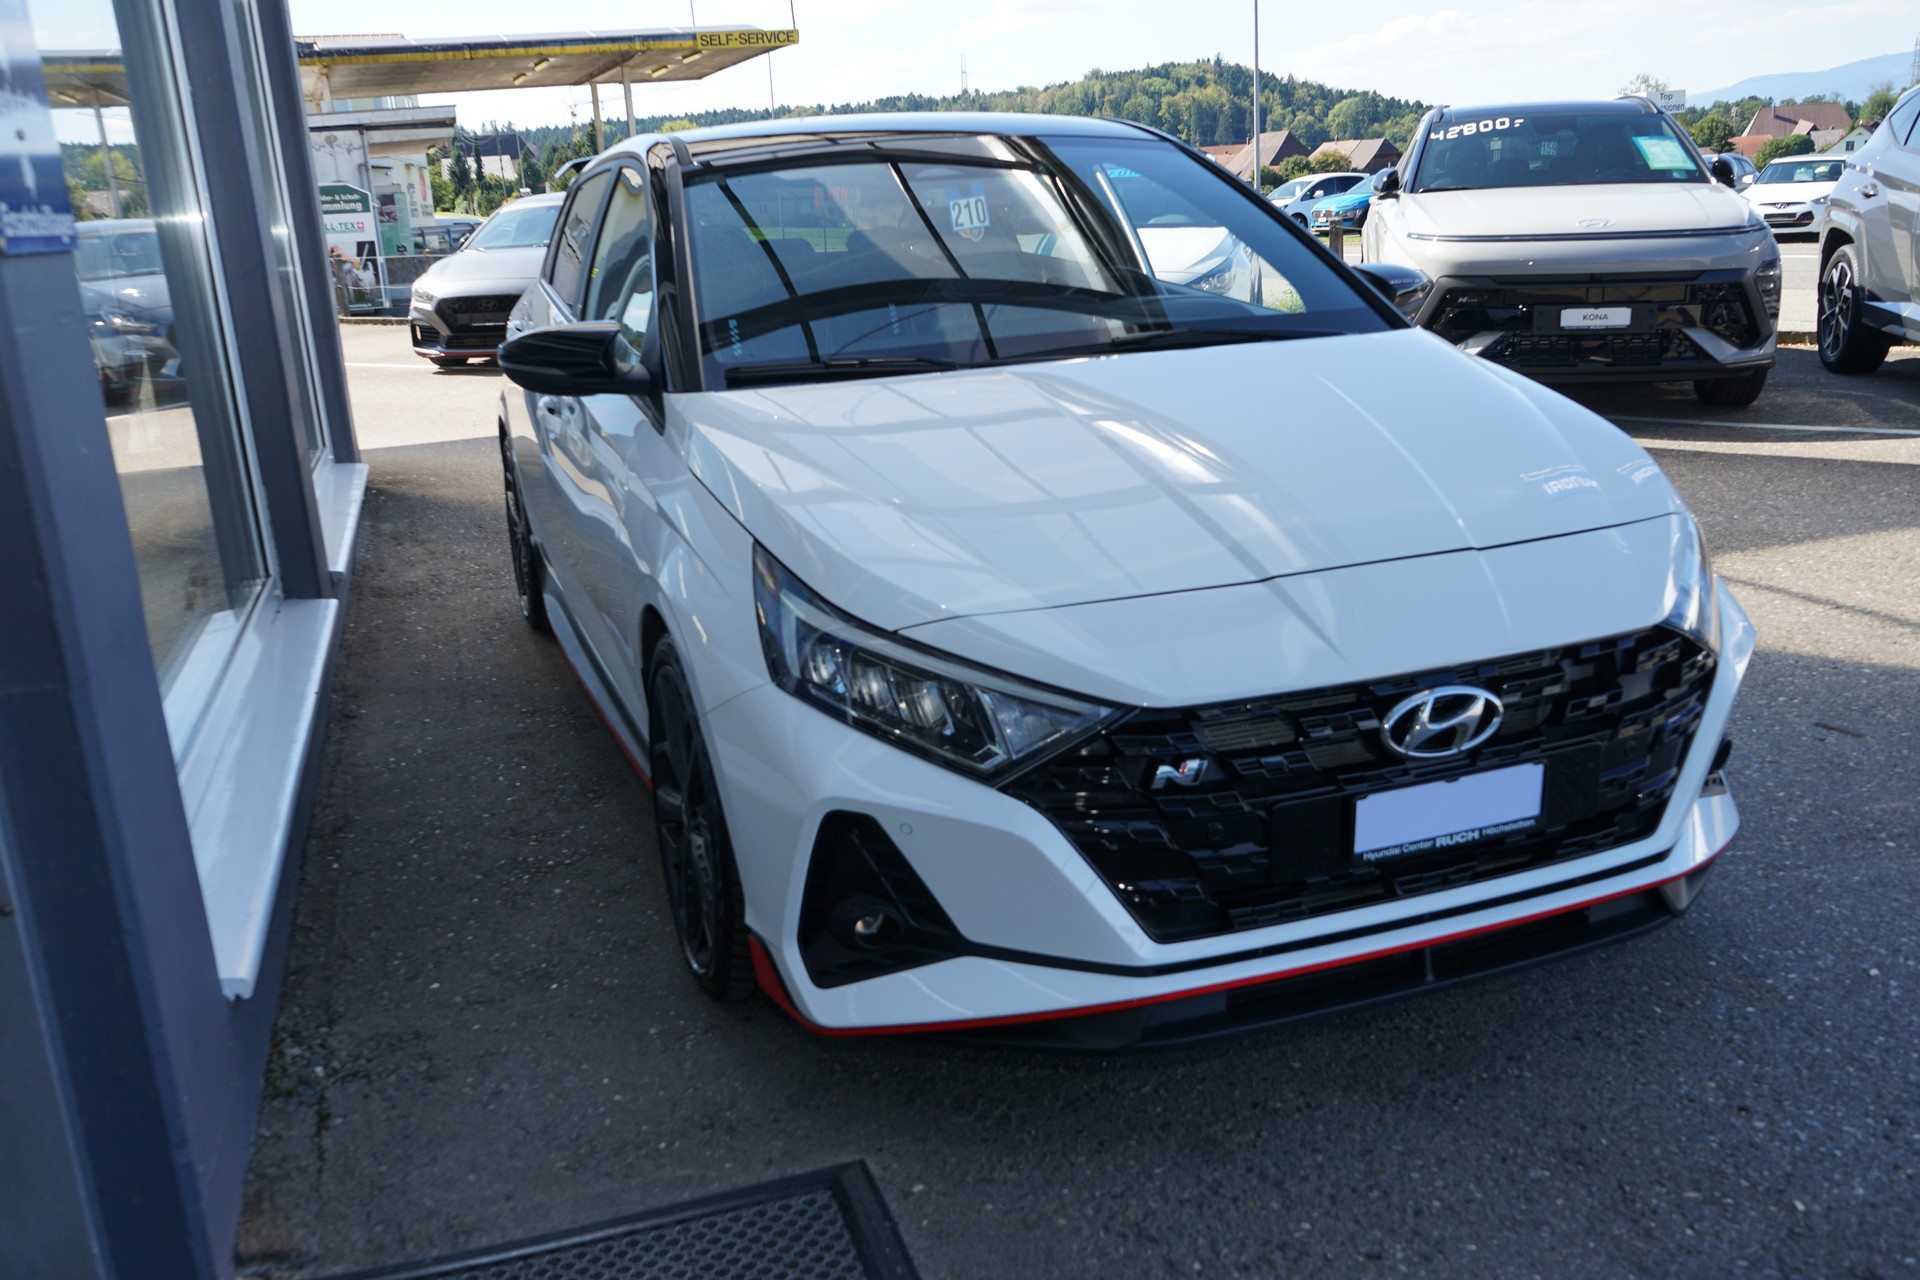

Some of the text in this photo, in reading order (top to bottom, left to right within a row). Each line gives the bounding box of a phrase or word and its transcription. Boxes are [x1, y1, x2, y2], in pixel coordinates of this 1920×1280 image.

[700, 31, 796, 47] SELF-SERVICE
[1660, 92, 1674, 101] Top
[321, 201, 363, 212] mmlung
[952, 198, 987, 228] 210
[1582, 313, 1609, 321] KONA
[1363, 847, 1401, 861] Hyundai
[1402, 840, 1434, 853] Center
[1435, 829, 1481, 848] RUCH
